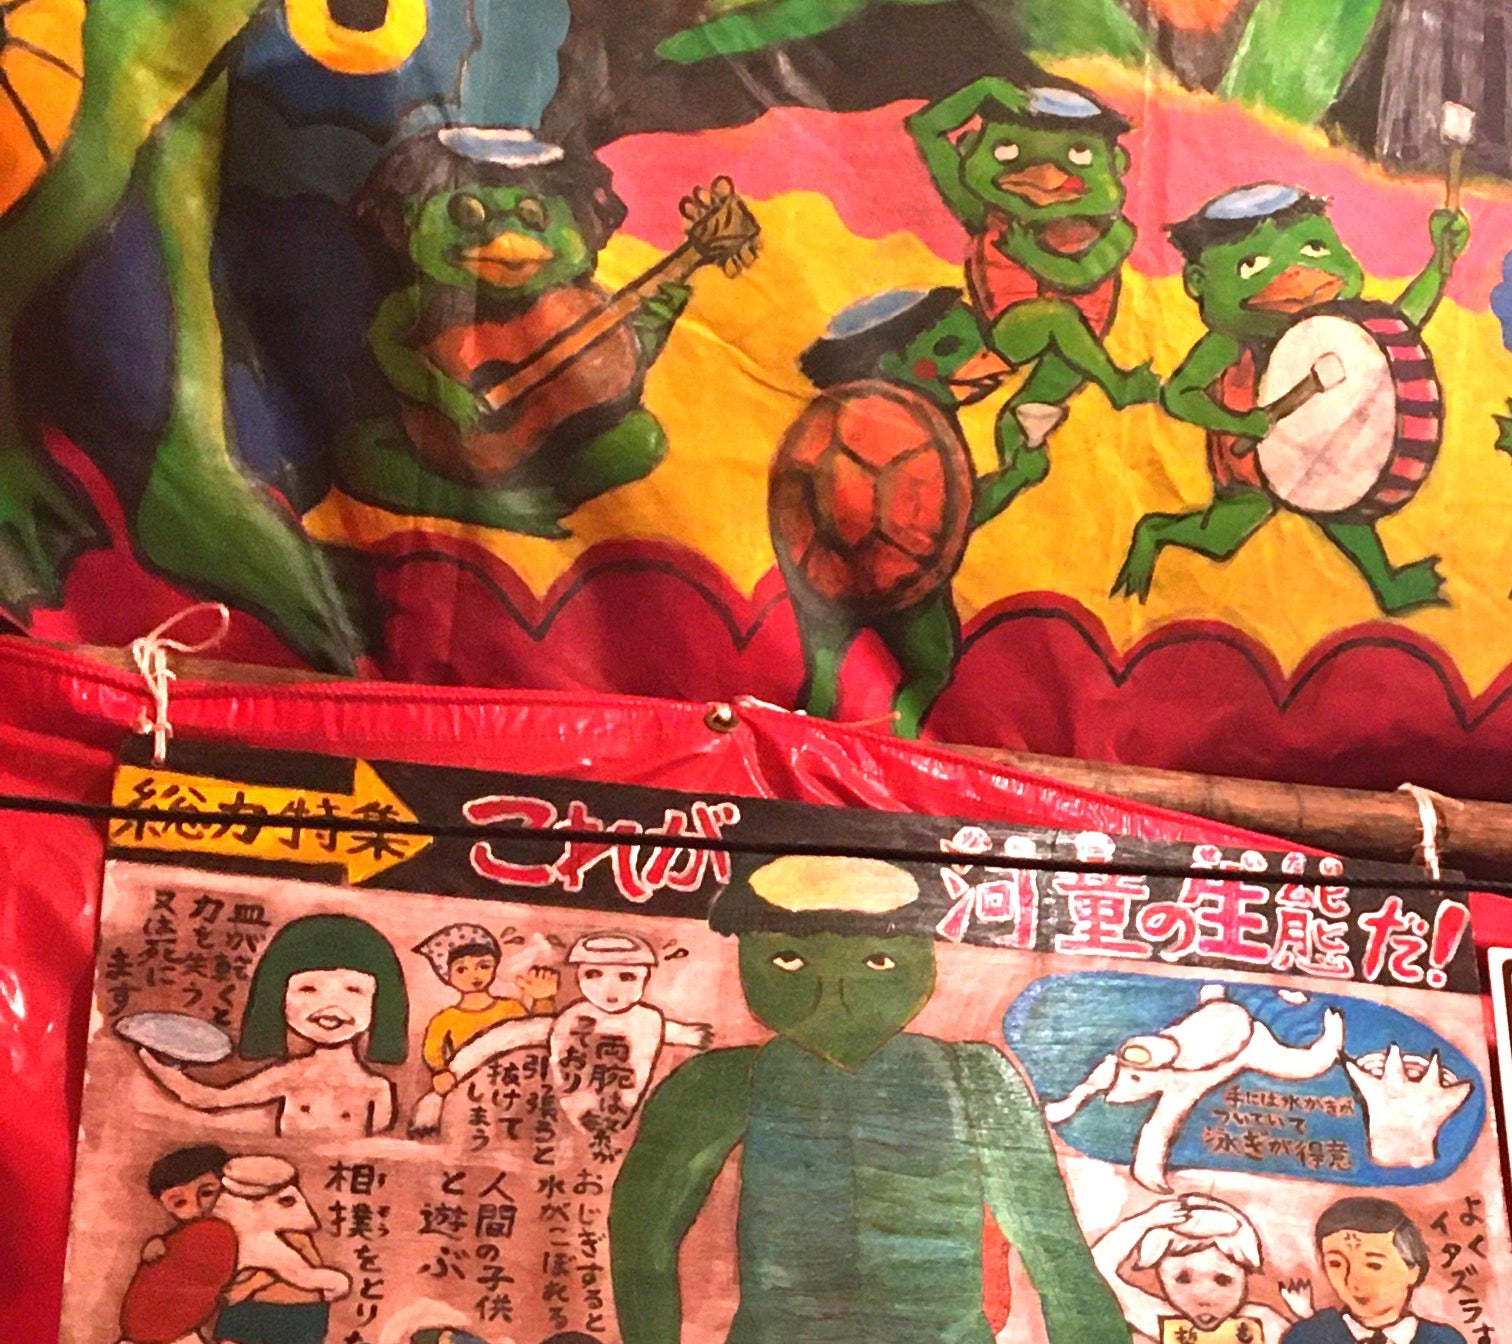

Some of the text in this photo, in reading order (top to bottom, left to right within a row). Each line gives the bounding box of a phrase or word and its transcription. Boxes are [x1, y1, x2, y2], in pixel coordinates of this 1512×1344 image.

[113, 777, 410, 861] 総力特集
[467, 1082, 491, 1151] しまう
[417, 1171, 471, 1280] と遊ぶ
[475, 1172, 518, 1323] 人間の子供
